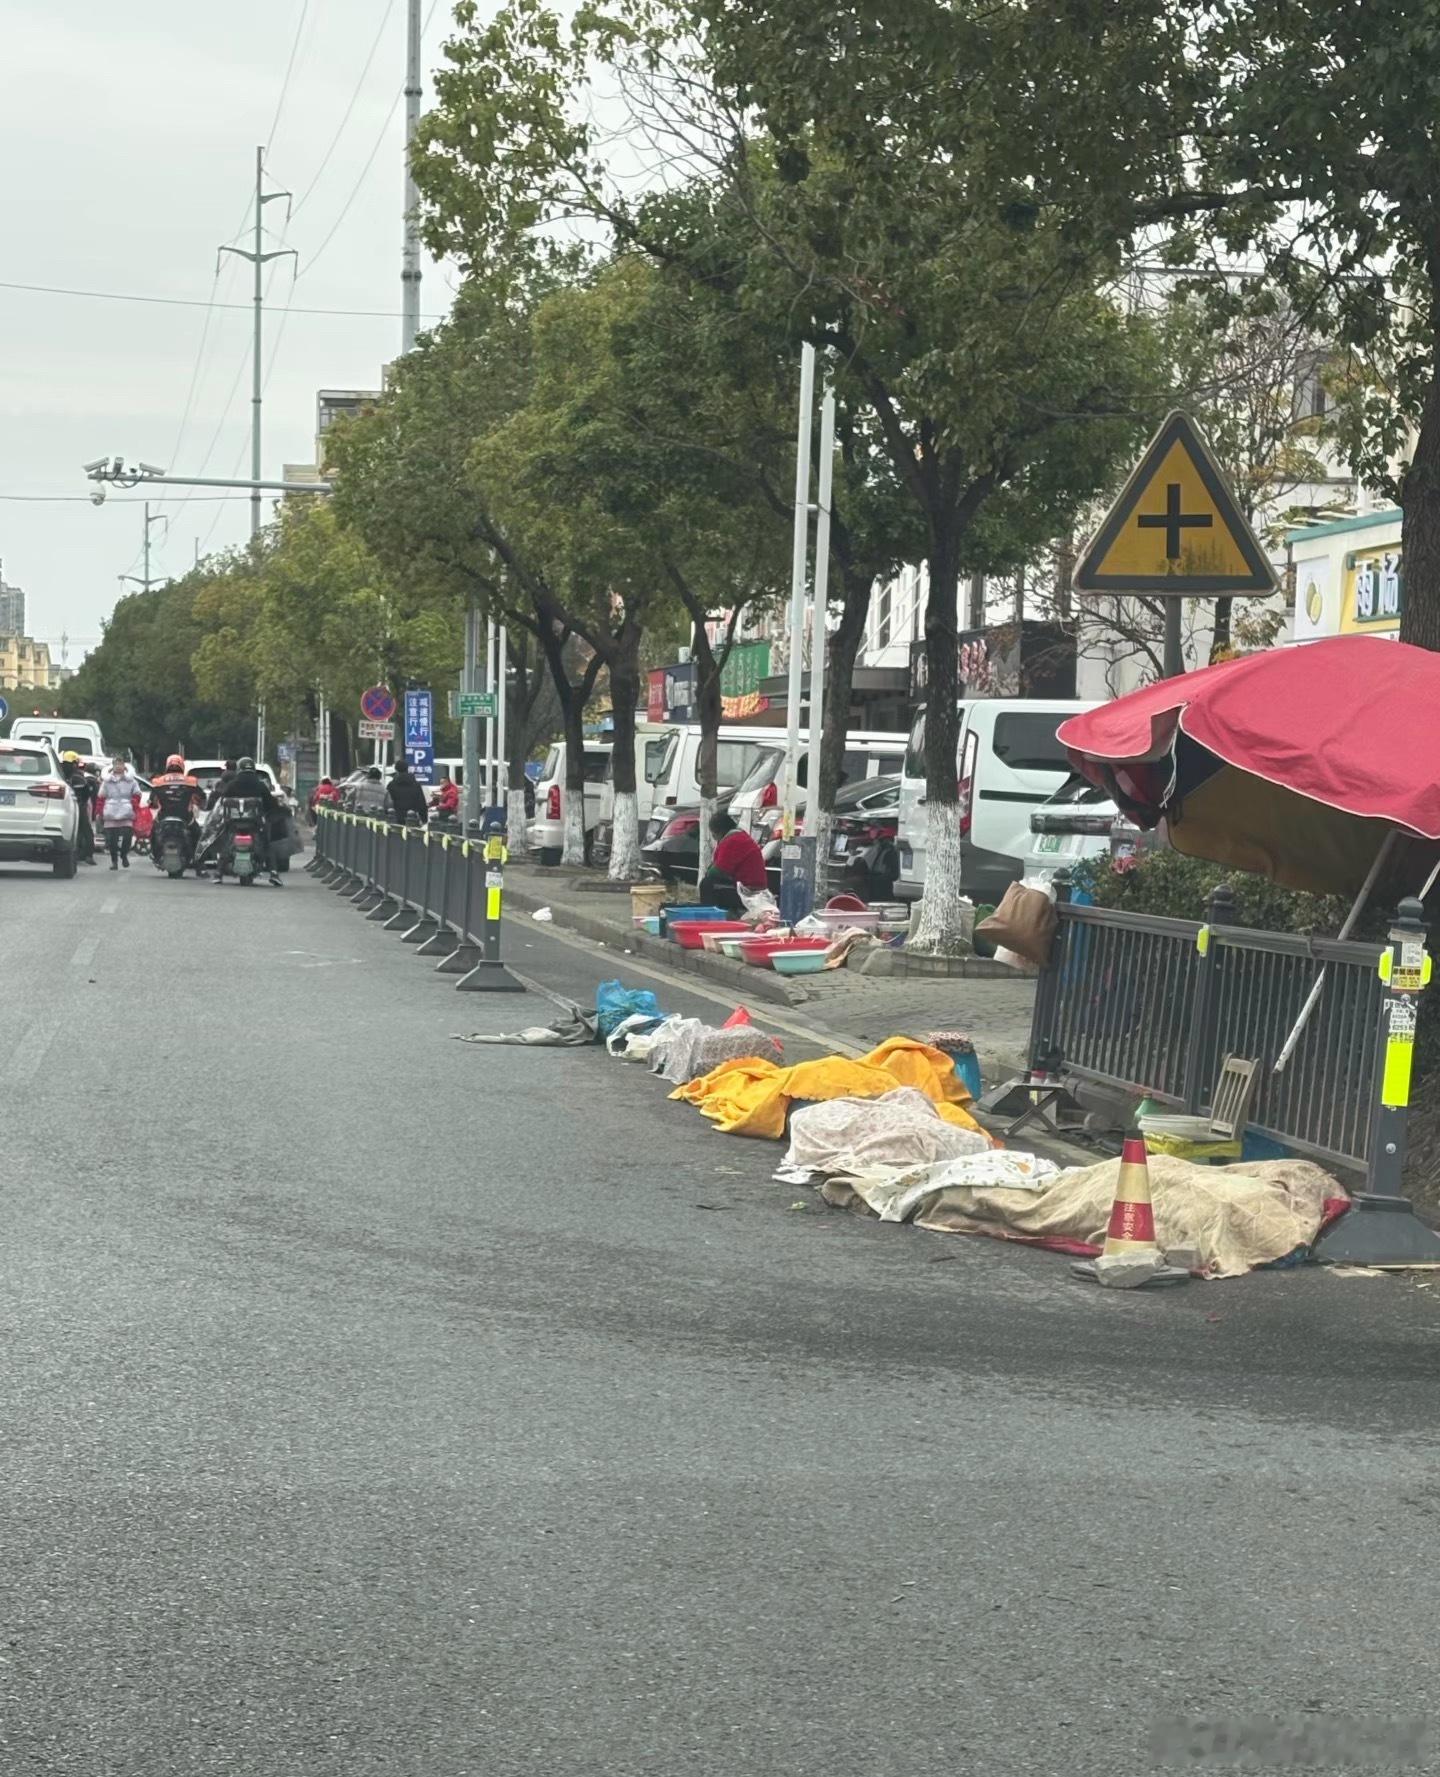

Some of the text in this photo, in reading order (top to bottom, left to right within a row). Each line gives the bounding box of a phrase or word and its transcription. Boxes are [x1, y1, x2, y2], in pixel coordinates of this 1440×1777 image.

[408, 697, 418, 736] 注意行人
[414, 751, 426, 764] P
[1122, 1203, 1136, 1240] 注意安全
